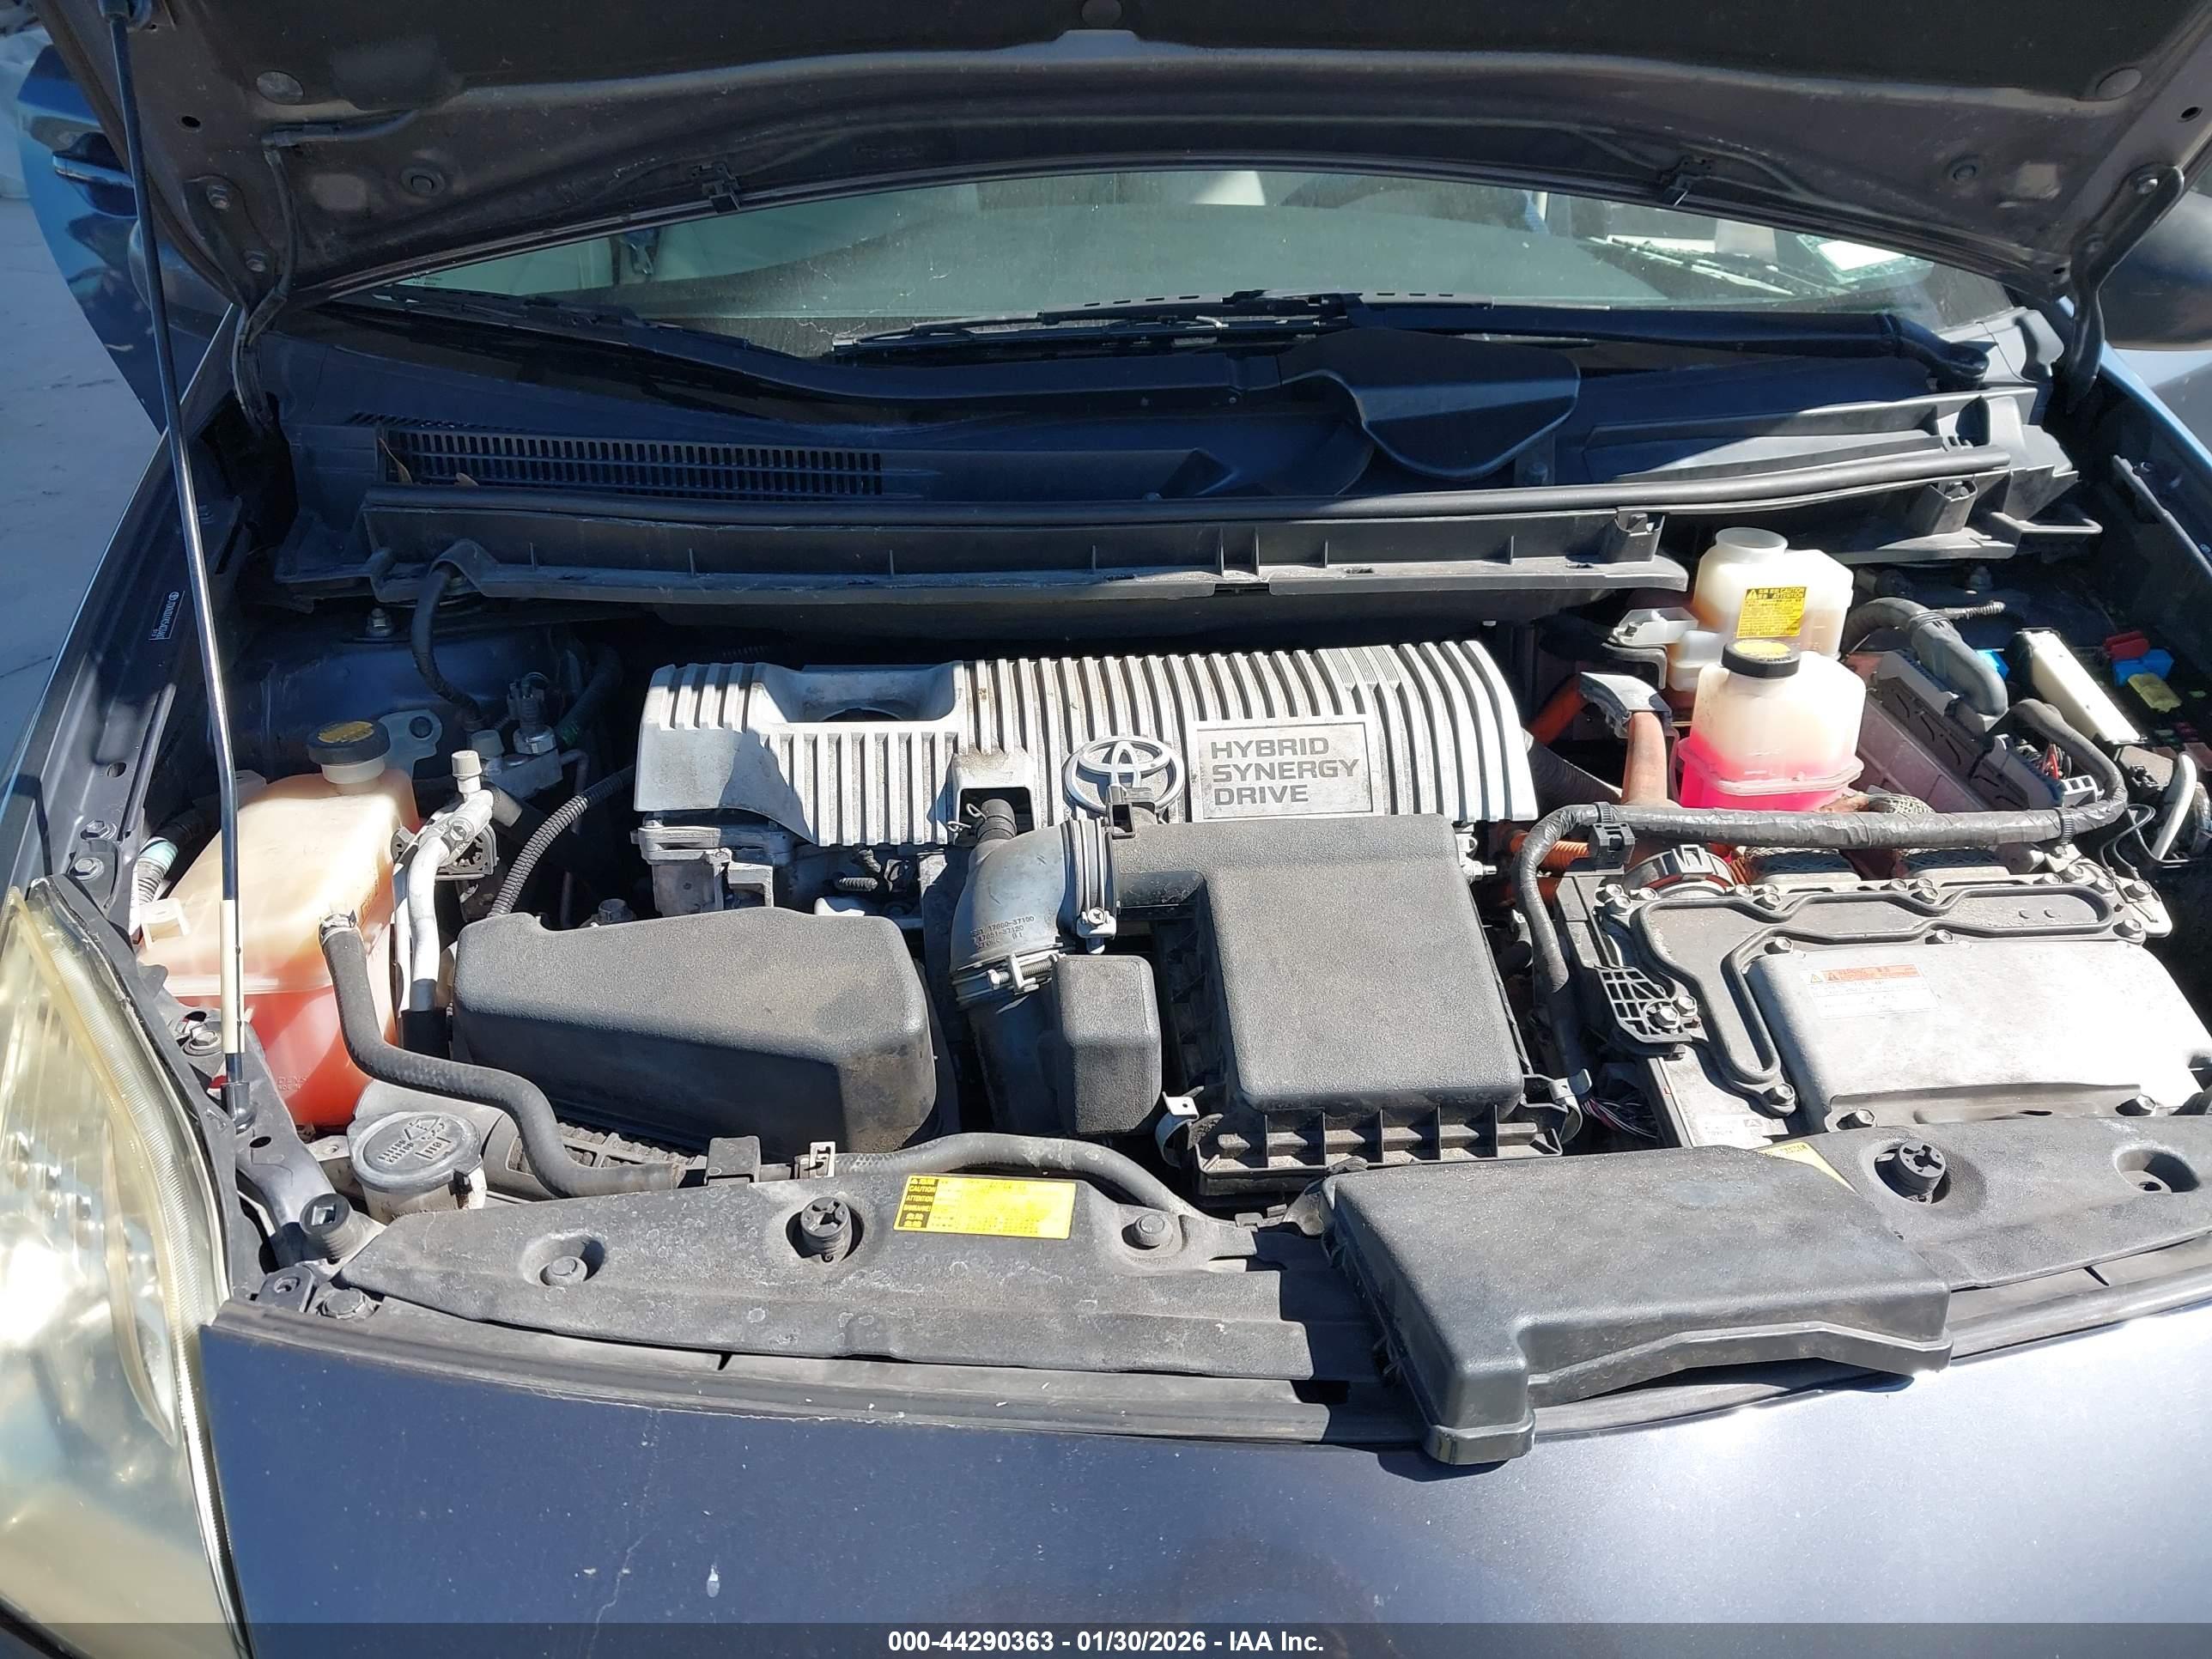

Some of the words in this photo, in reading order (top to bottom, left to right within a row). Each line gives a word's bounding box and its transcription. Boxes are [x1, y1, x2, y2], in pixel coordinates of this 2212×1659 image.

[1211, 737, 1329, 759] HYBRID
[1212, 758, 1359, 783] SYNERGY
[1214, 784, 1309, 806] DRIVE
